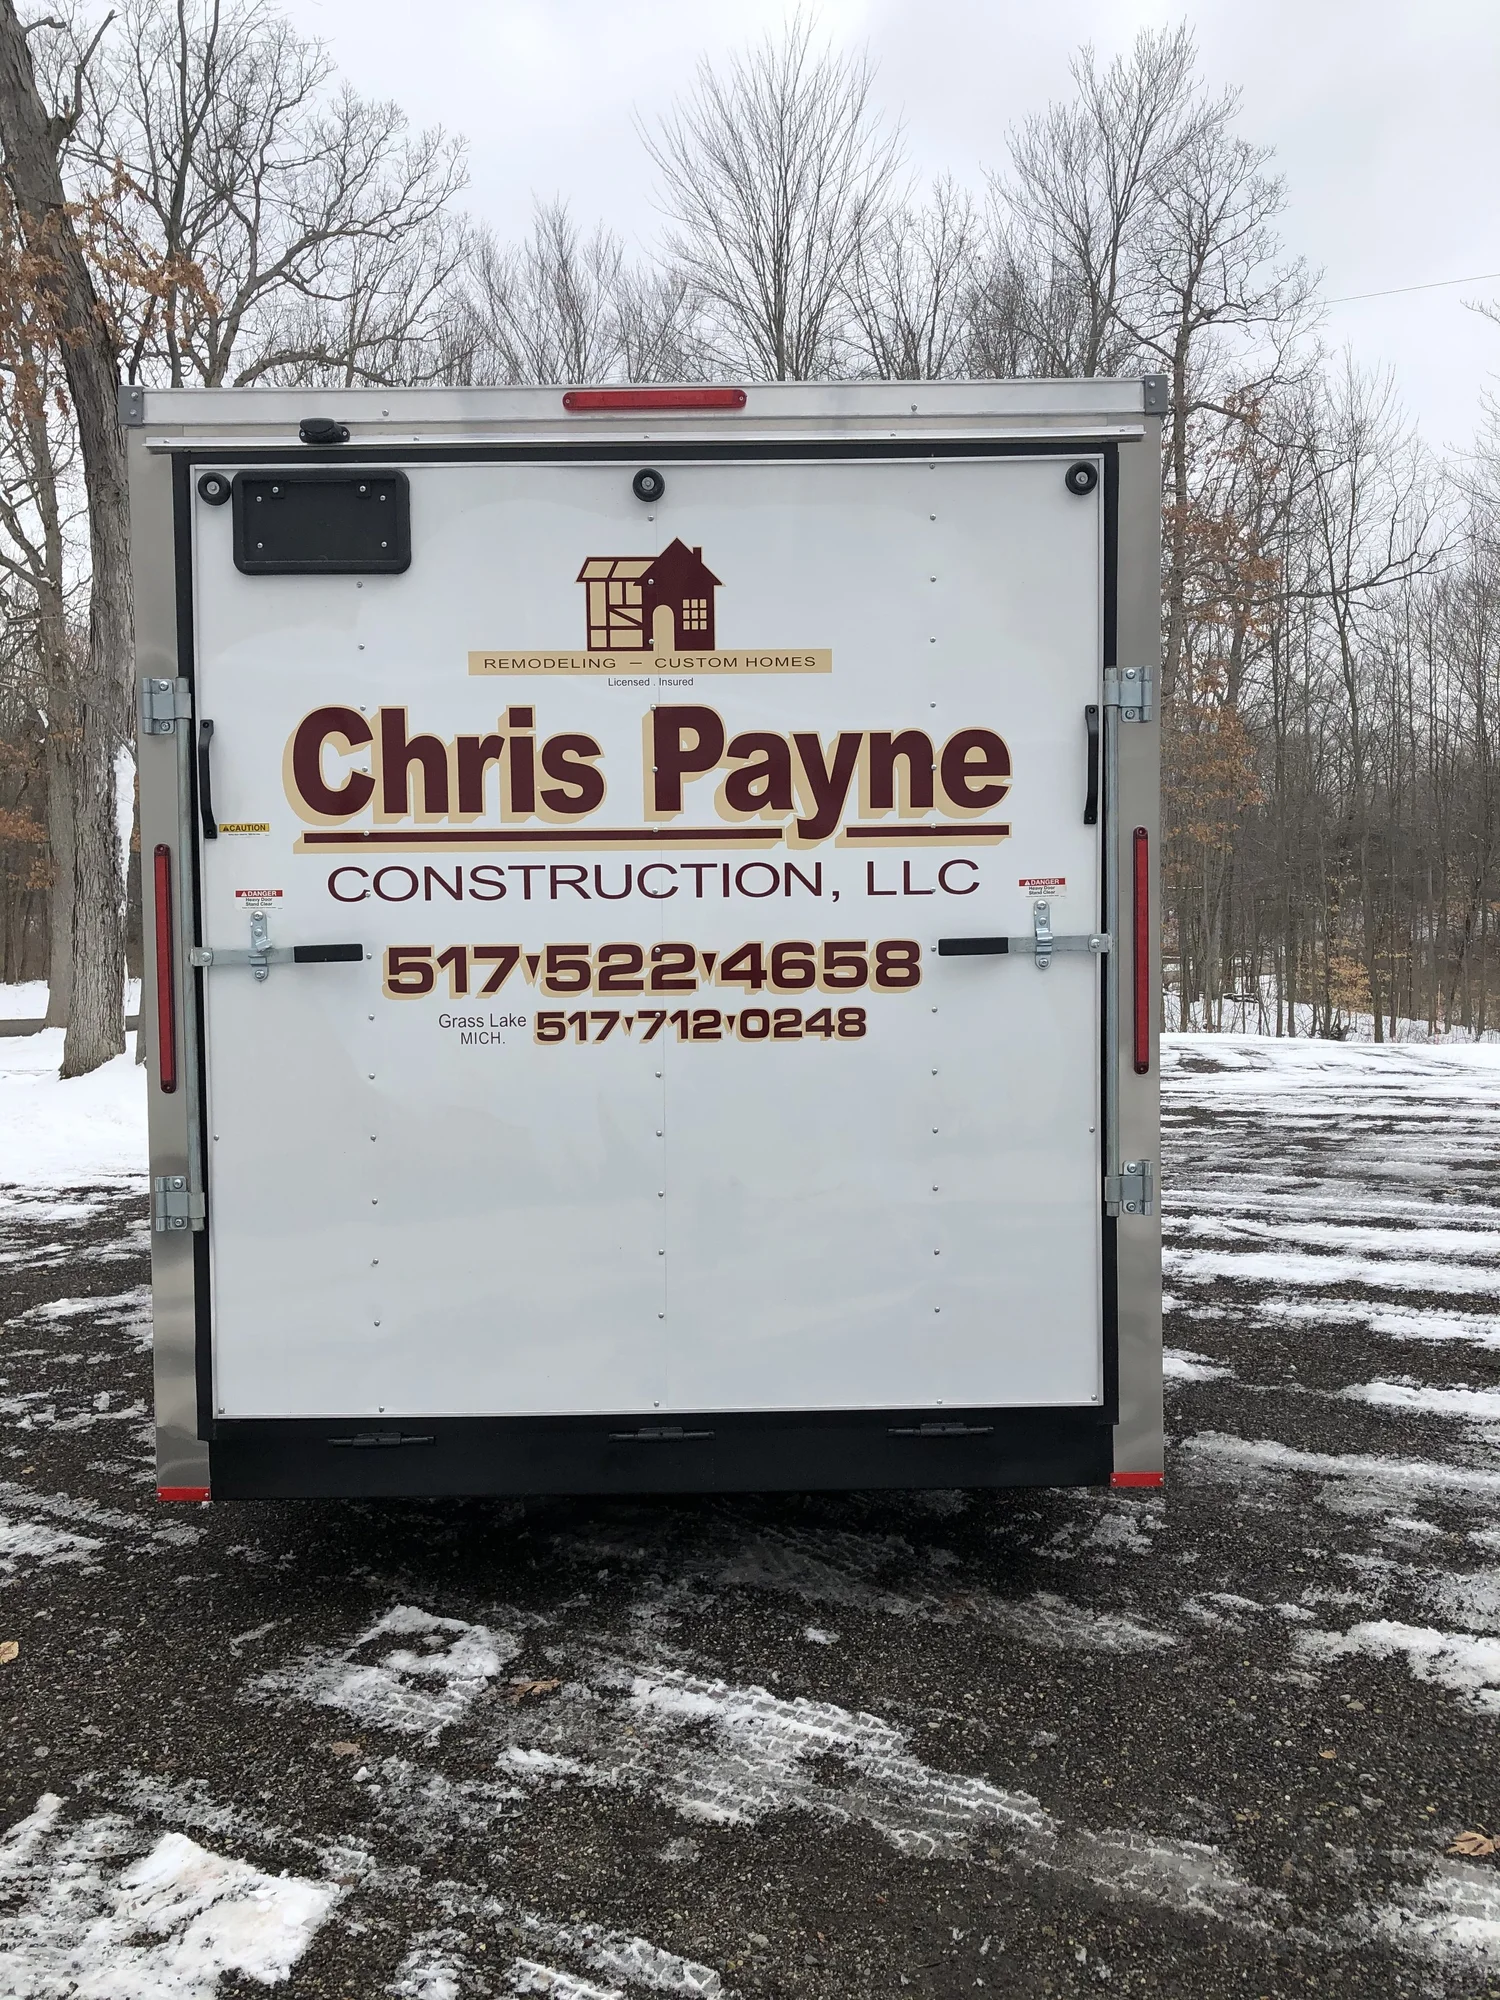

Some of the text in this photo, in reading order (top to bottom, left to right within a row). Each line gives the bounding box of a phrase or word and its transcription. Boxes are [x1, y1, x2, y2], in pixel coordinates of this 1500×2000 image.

[484, 658, 616, 669] REMODELING
[654, 657, 738, 669] CUSTOM
[745, 656, 816, 668] HOMES
[608, 678, 650, 687] Licensed
[659, 677, 694, 687] Insured
[283, 703, 1012, 850] Chris Payne
[229, 824, 266, 832] CAUTION
[327, 858, 980, 903] CONSTRUCTION, LLC
[438, 1013, 485, 1028] Grass
[489, 1013, 527, 1027] Lake
[460, 1031, 506, 1044] MICH.
